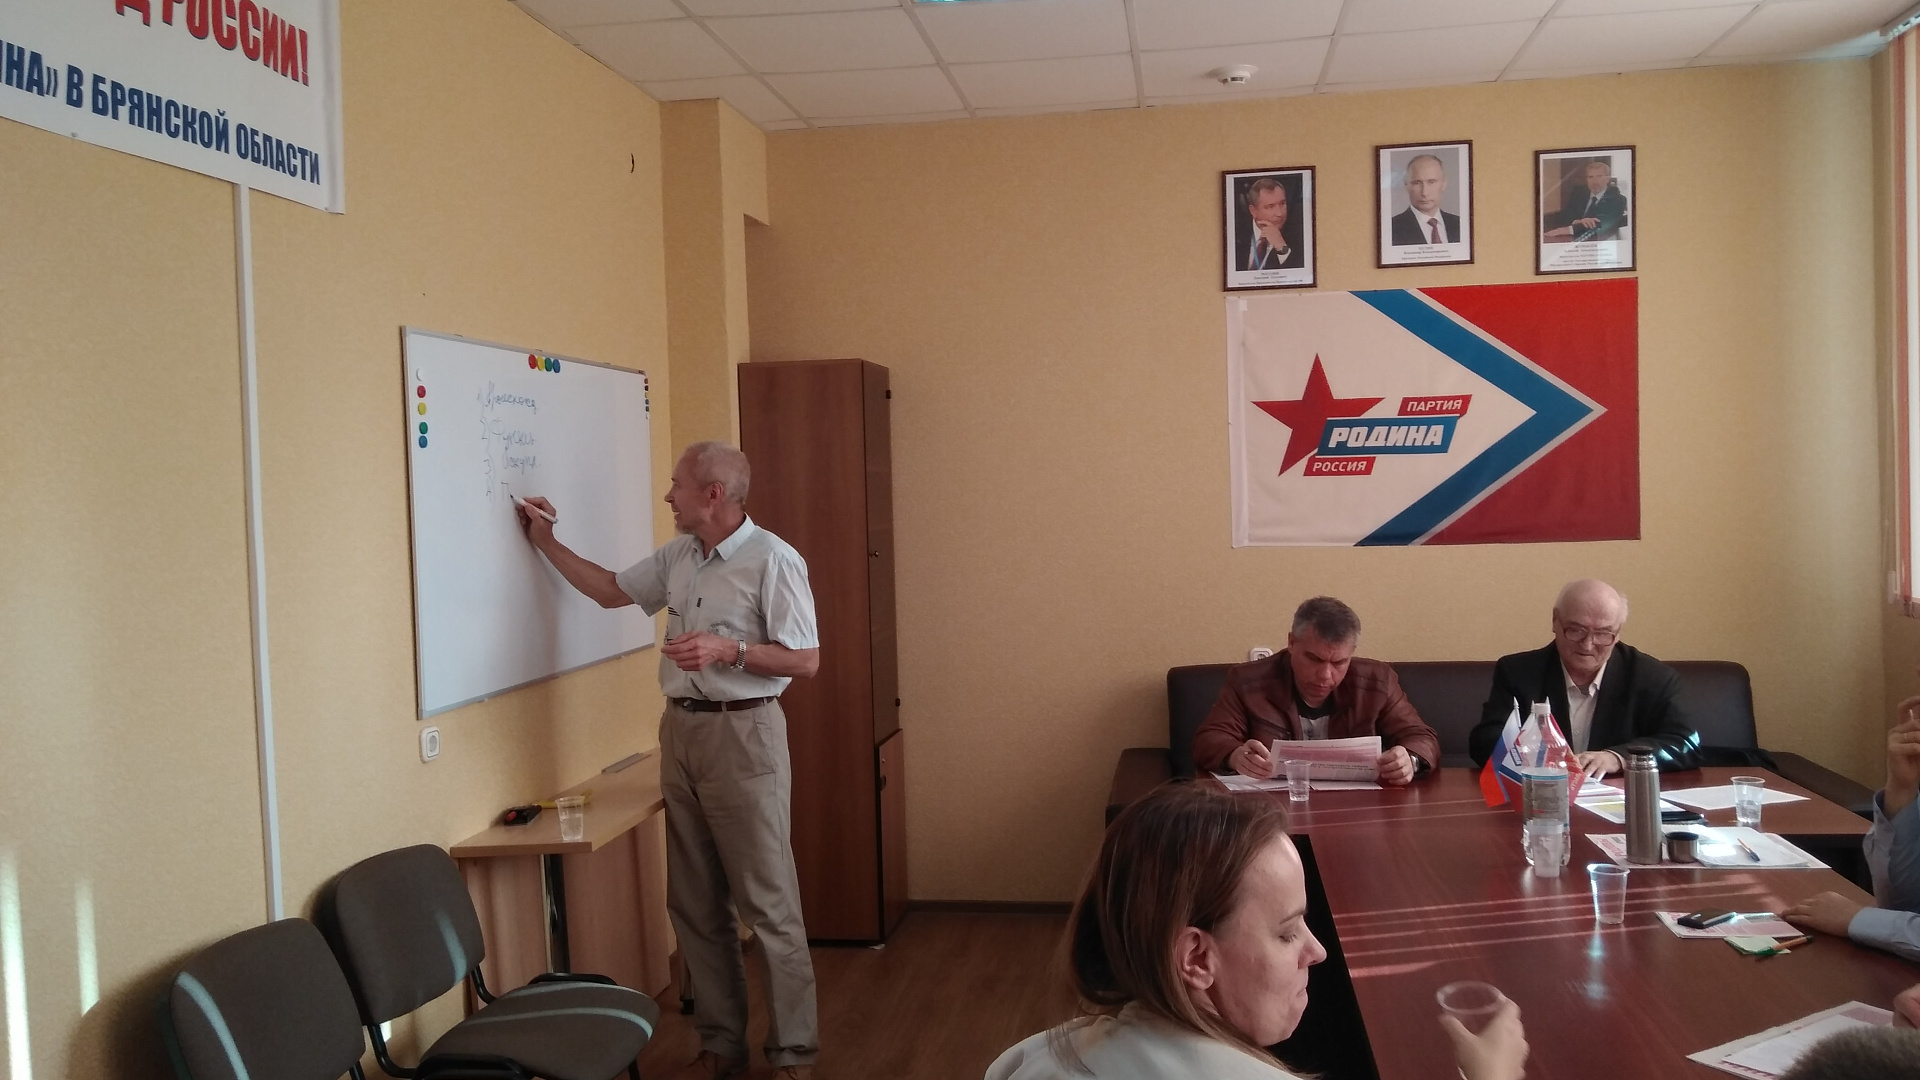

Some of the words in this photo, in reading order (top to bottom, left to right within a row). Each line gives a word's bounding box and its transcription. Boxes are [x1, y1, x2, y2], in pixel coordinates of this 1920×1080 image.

[0, 39, 58, 97] НА»
[66, 63, 84, 109] В
[92, 73, 230, 155] БРЯНСКОЙ
[236, 123, 321, 186] ОБЛАСТИ
[1406, 399, 1463, 412] ПАРТИЯ
[1328, 424, 1445, 448] РОДИНА
[1312, 460, 1367, 473] РОССИЯ
